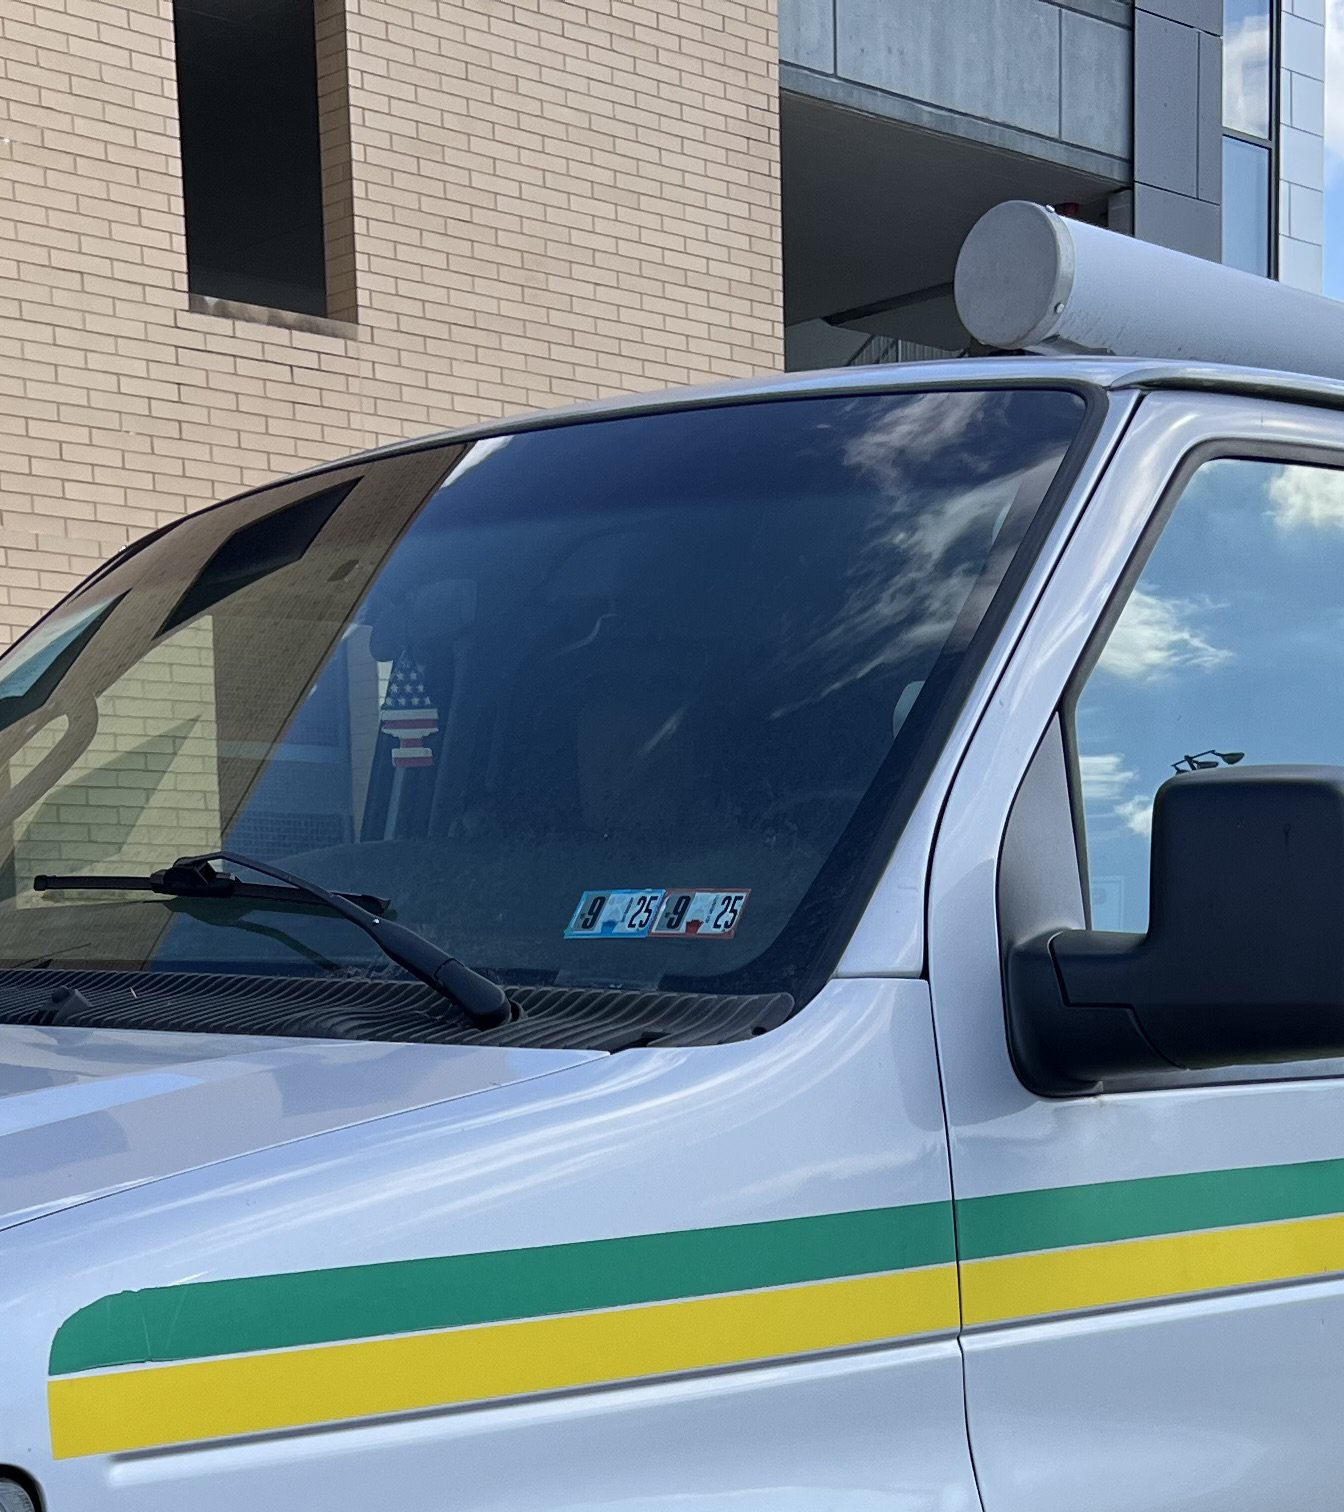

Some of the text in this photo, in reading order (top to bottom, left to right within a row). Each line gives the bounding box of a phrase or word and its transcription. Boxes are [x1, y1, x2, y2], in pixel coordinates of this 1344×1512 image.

[581, 896, 606, 929] 9
[627, 896, 658, 929] 25
[666, 895, 691, 929] 9
[712, 895, 743, 929] 25
